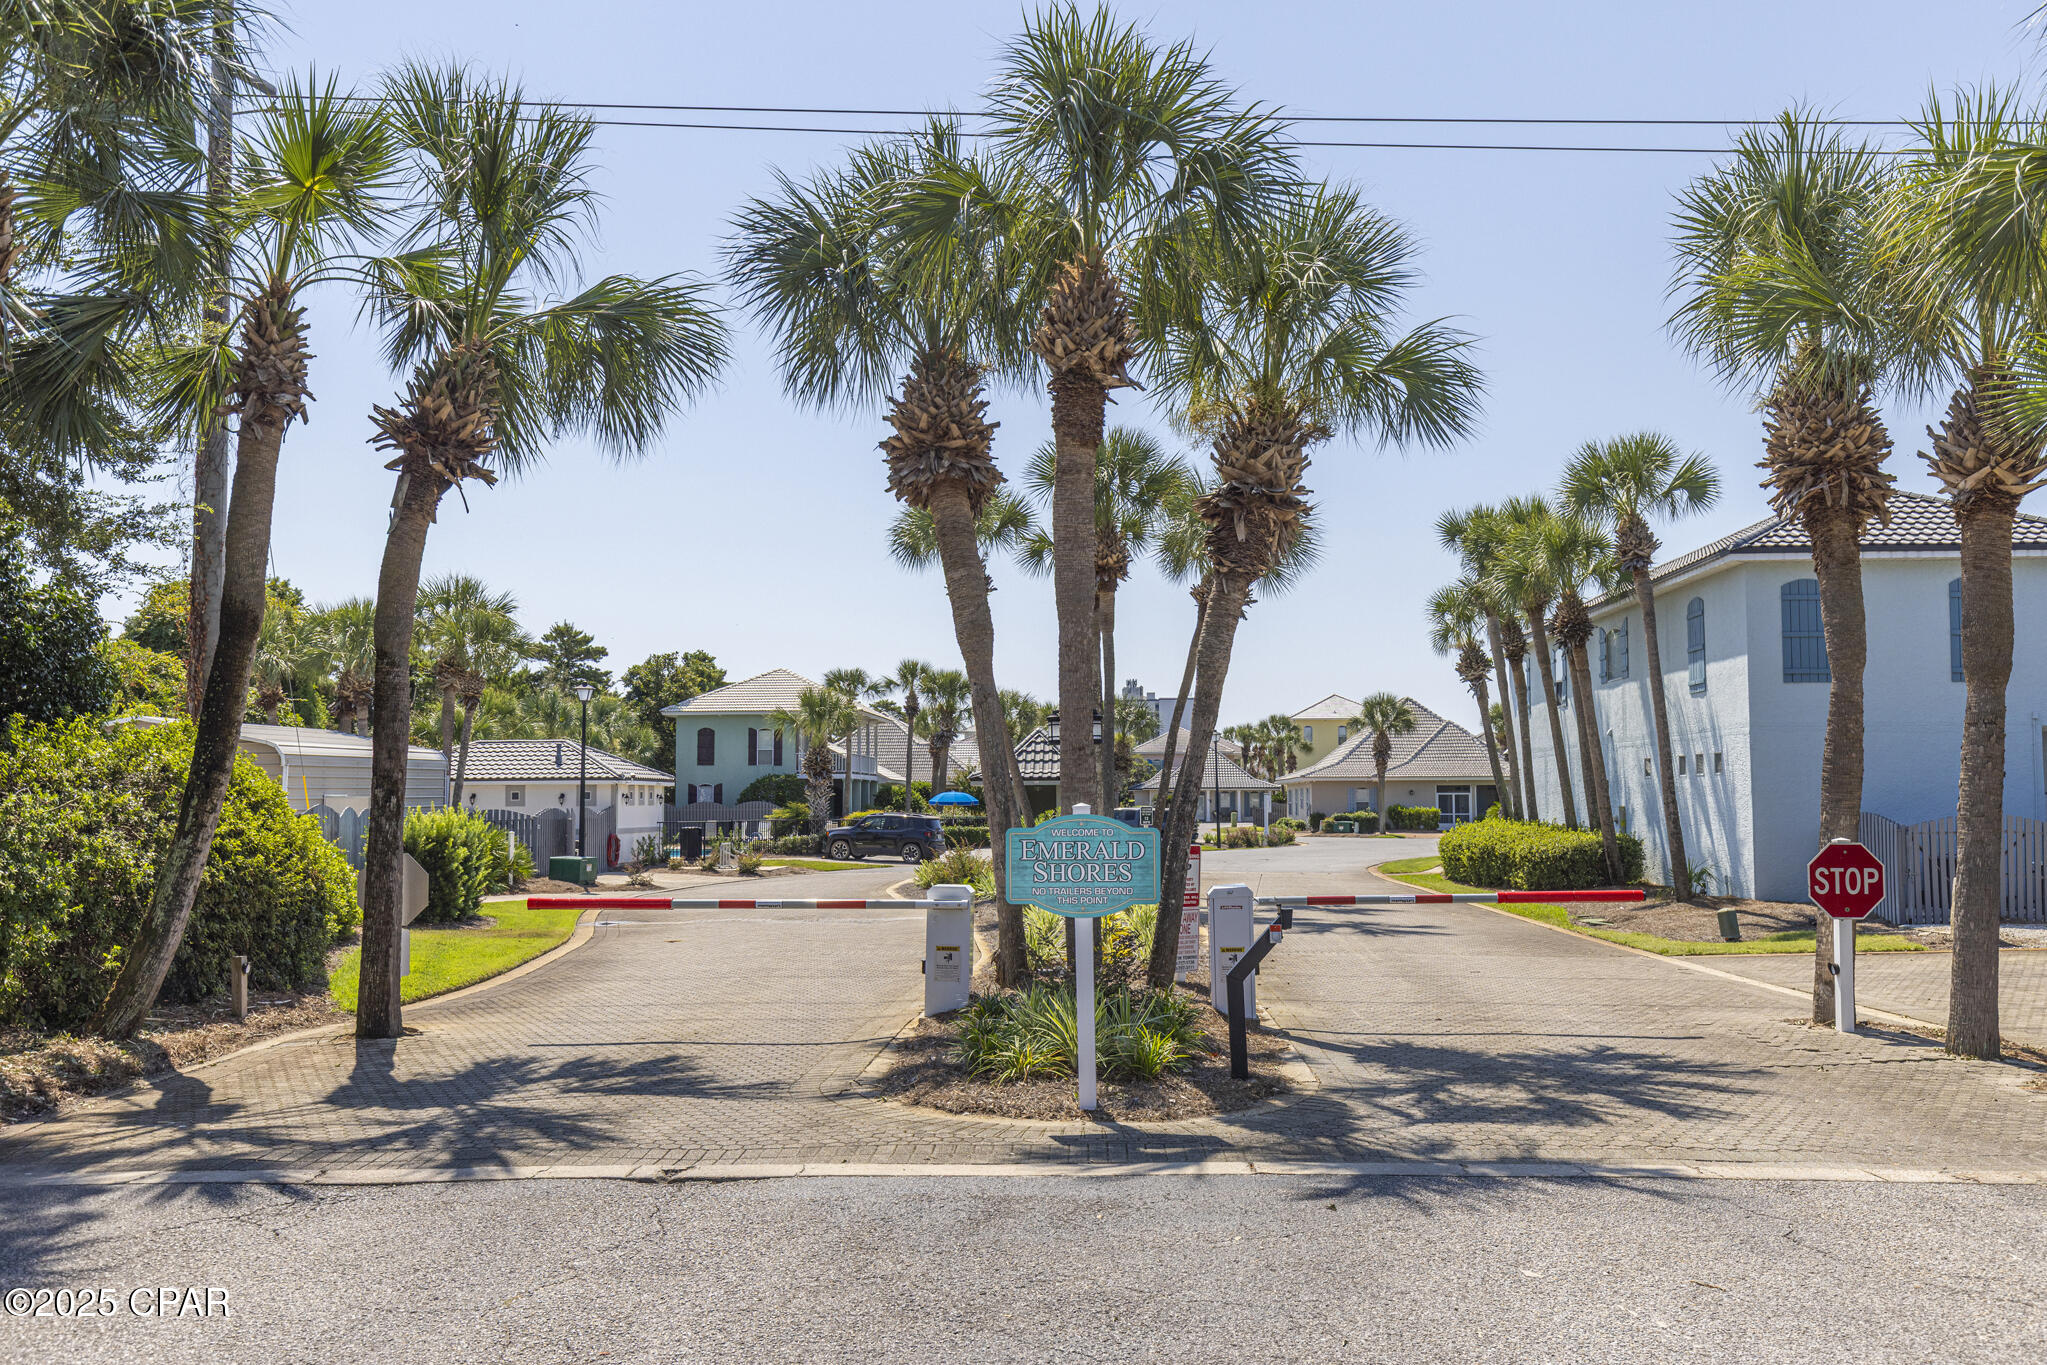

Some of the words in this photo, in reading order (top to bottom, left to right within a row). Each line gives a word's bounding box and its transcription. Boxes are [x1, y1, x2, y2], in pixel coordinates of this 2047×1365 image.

[1051, 828, 1099, 837] WELCOME
[1101, 828, 1114, 837] TO
[1019, 839, 1145, 861] EMERALD
[1033, 861, 1133, 883] SHORES
[1814, 867, 1879, 895] STOP
[1032, 887, 1046, 896] NO
[1048, 887, 1092, 896] TRAILERS
[1094, 887, 1133, 896] BEYOND
[1057, 896, 1078, 905] THIS
[1080, 896, 1109, 905] POINT
[1180, 923, 1191, 935] ONE
